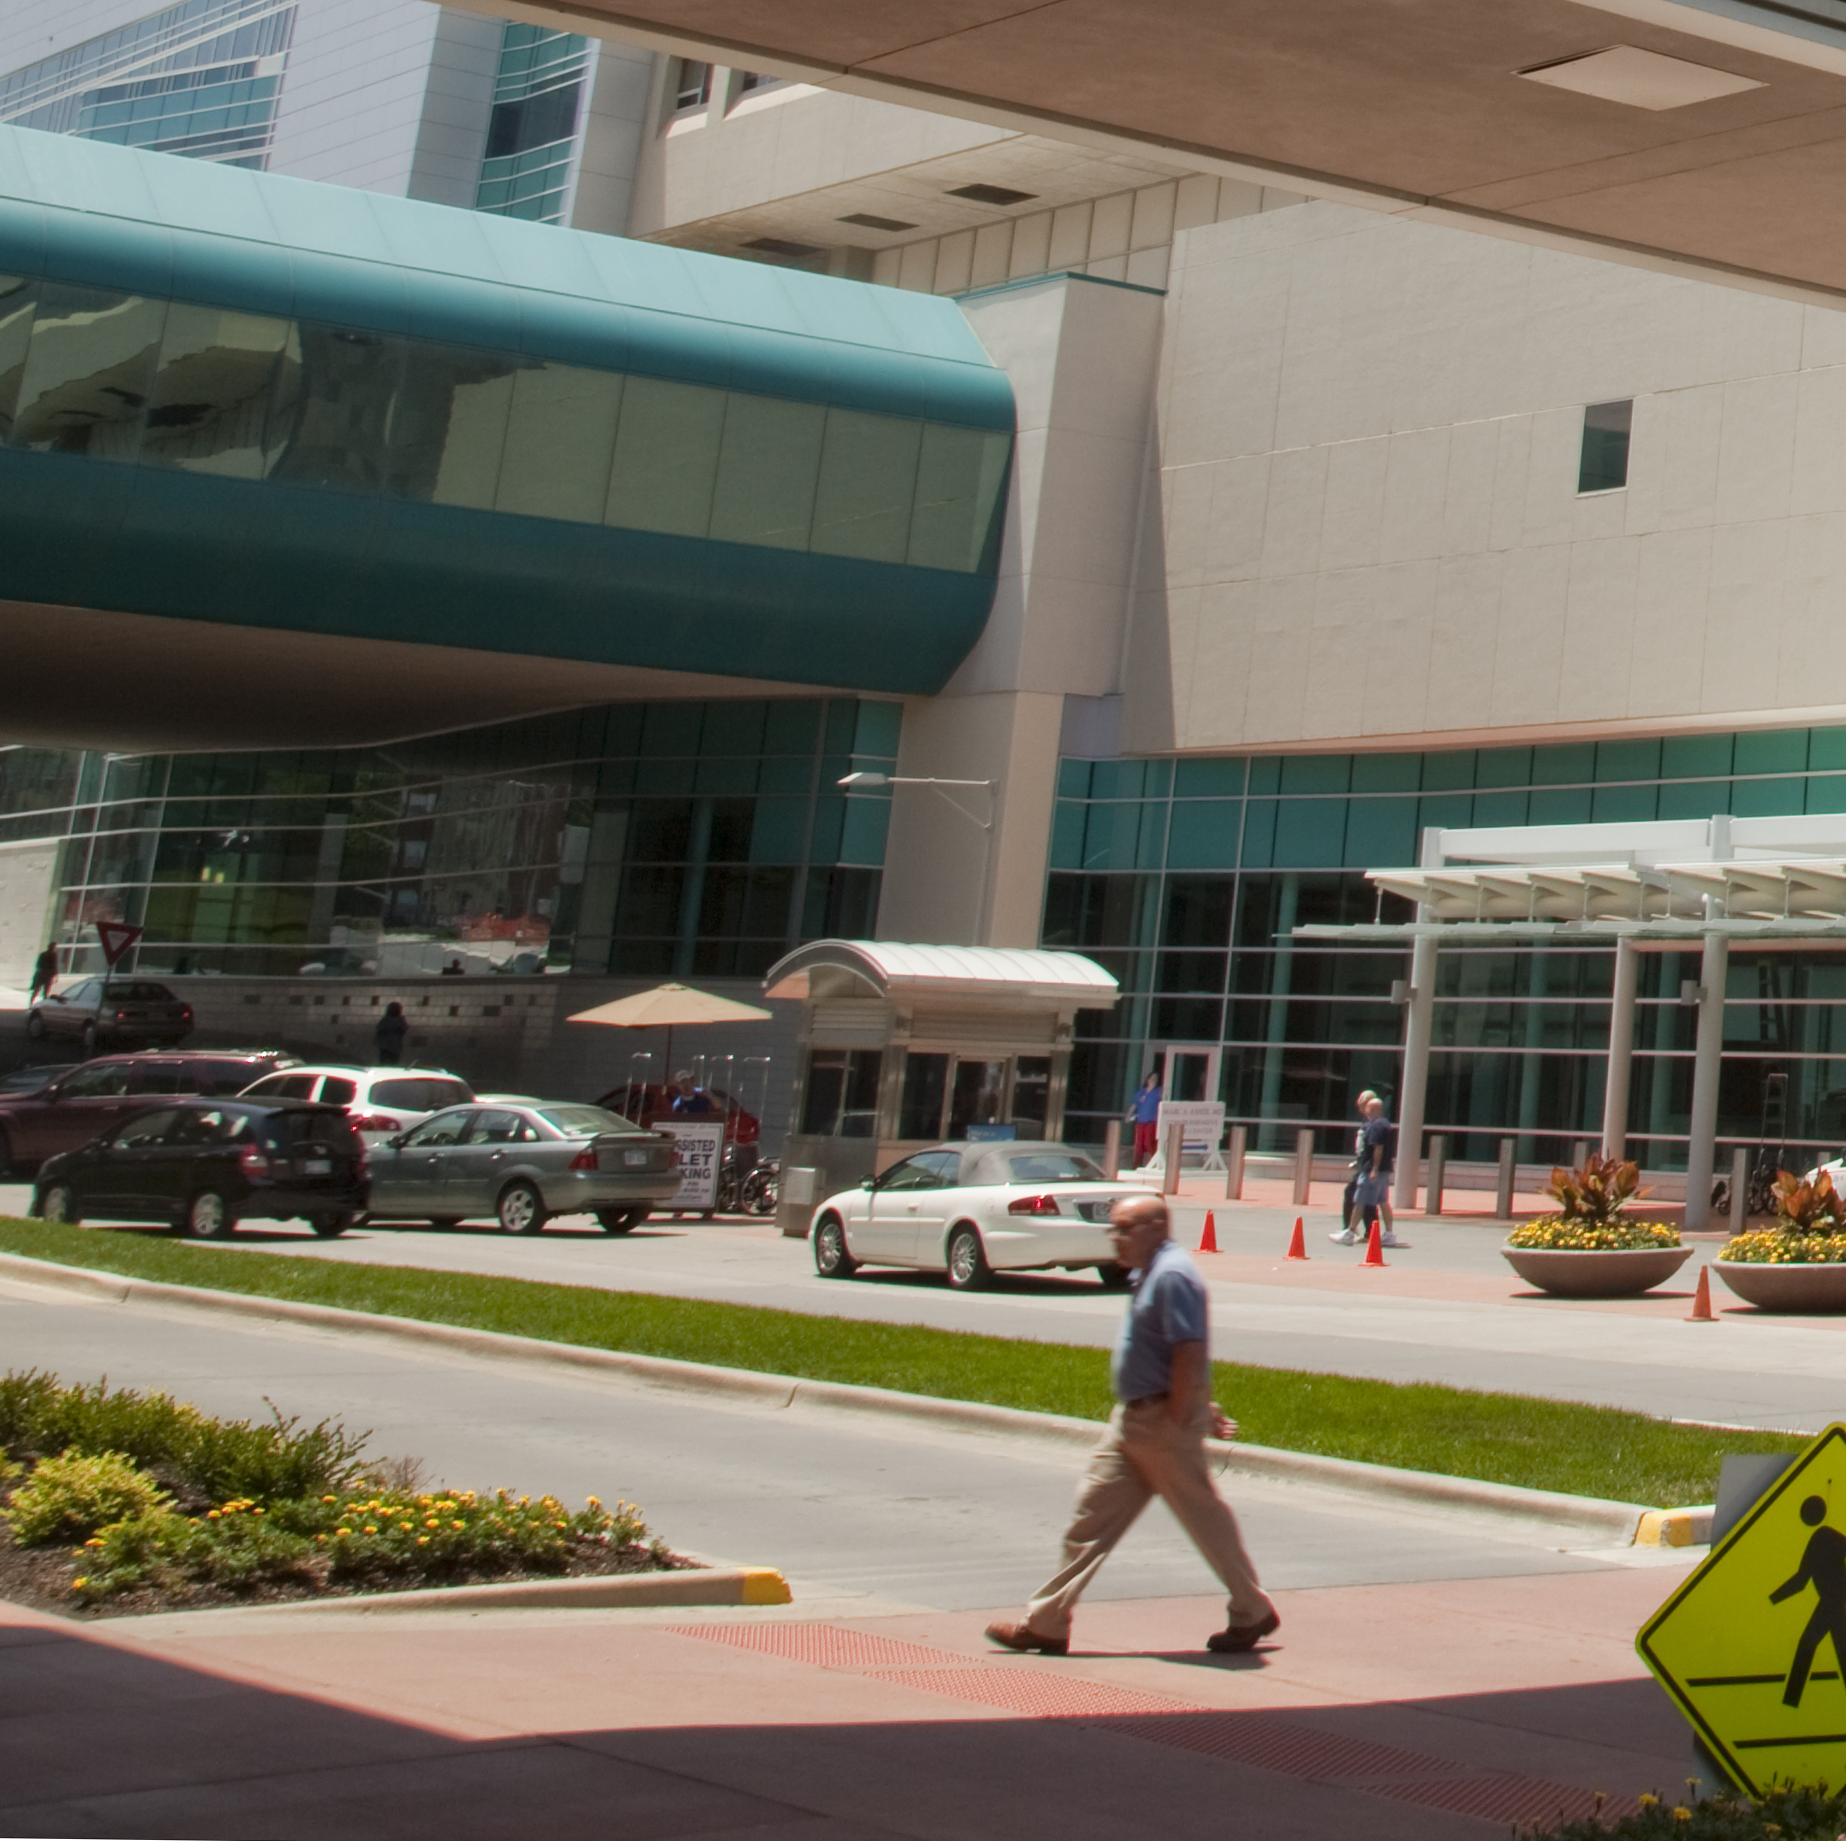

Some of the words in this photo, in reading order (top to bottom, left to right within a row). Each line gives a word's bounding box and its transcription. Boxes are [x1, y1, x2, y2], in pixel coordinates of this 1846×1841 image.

[676, 1139, 716, 1152] SSISTED
[679, 1154, 713, 1166] LET
[680, 1168, 712, 1180] KING
